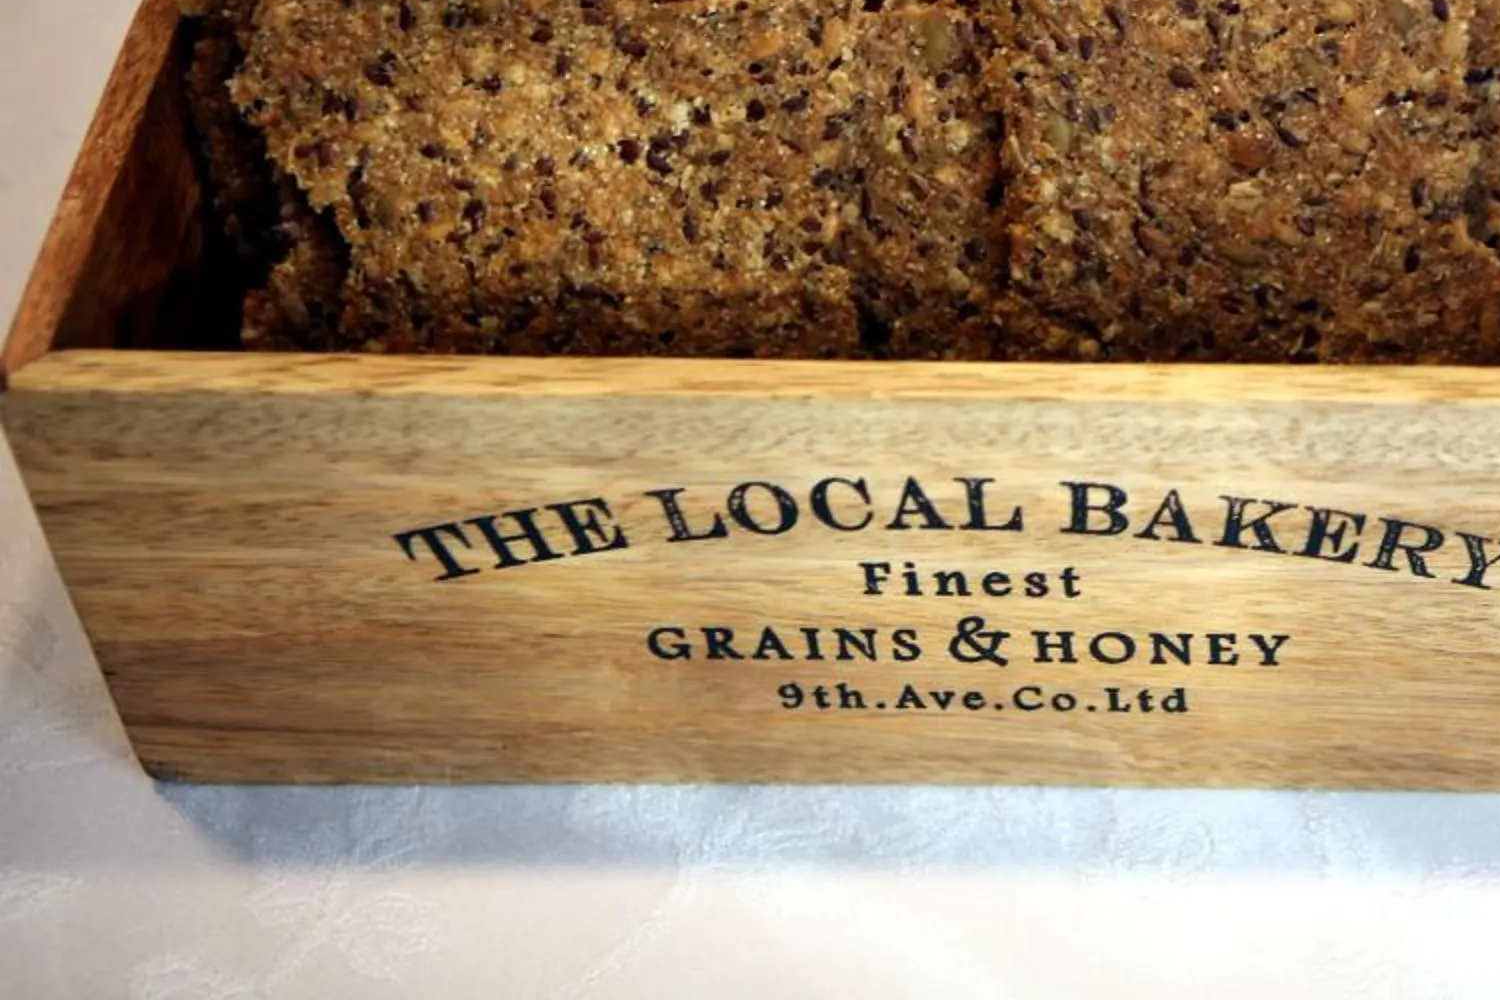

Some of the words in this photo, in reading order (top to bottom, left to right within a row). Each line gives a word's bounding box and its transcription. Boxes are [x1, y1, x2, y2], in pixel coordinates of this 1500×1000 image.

[393, 495, 631, 583] THE
[641, 475, 1024, 544] LOCAL
[859, 561, 1083, 599] Finest
[645, 625, 923, 663] GRAINS
[946, 615, 1012, 668] &
[1031, 630, 1292, 667] HONEY
